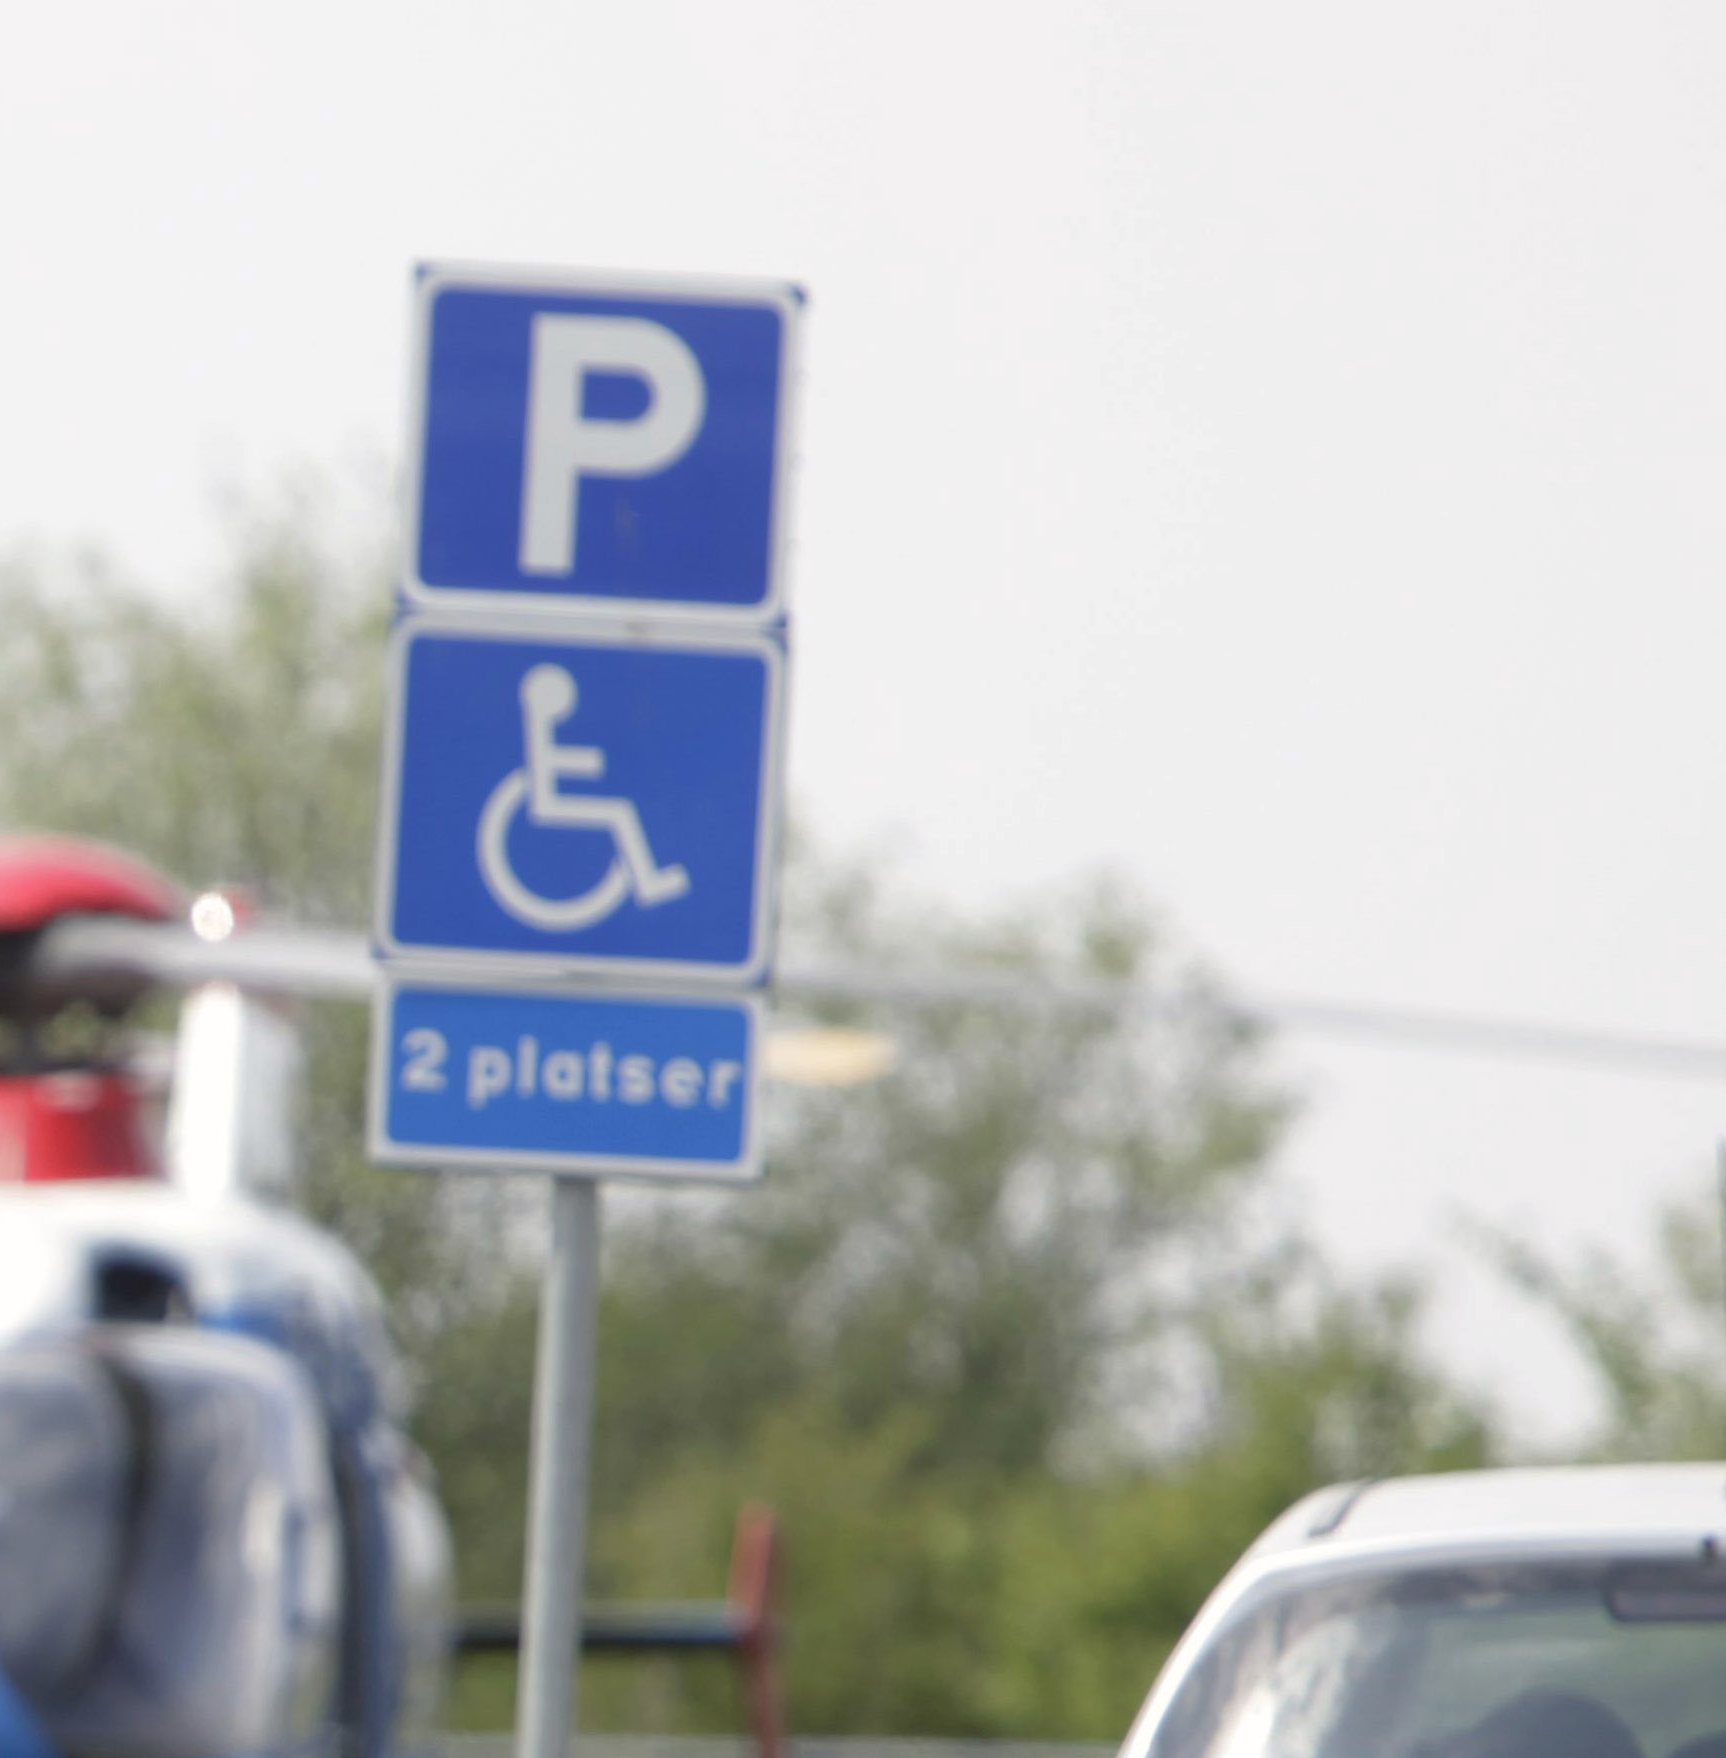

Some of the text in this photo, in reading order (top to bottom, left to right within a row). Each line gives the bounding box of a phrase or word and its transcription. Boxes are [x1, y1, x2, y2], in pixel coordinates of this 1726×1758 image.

[517, 311, 706, 576] P
[401, 1027, 742, 1110] 2 platser
